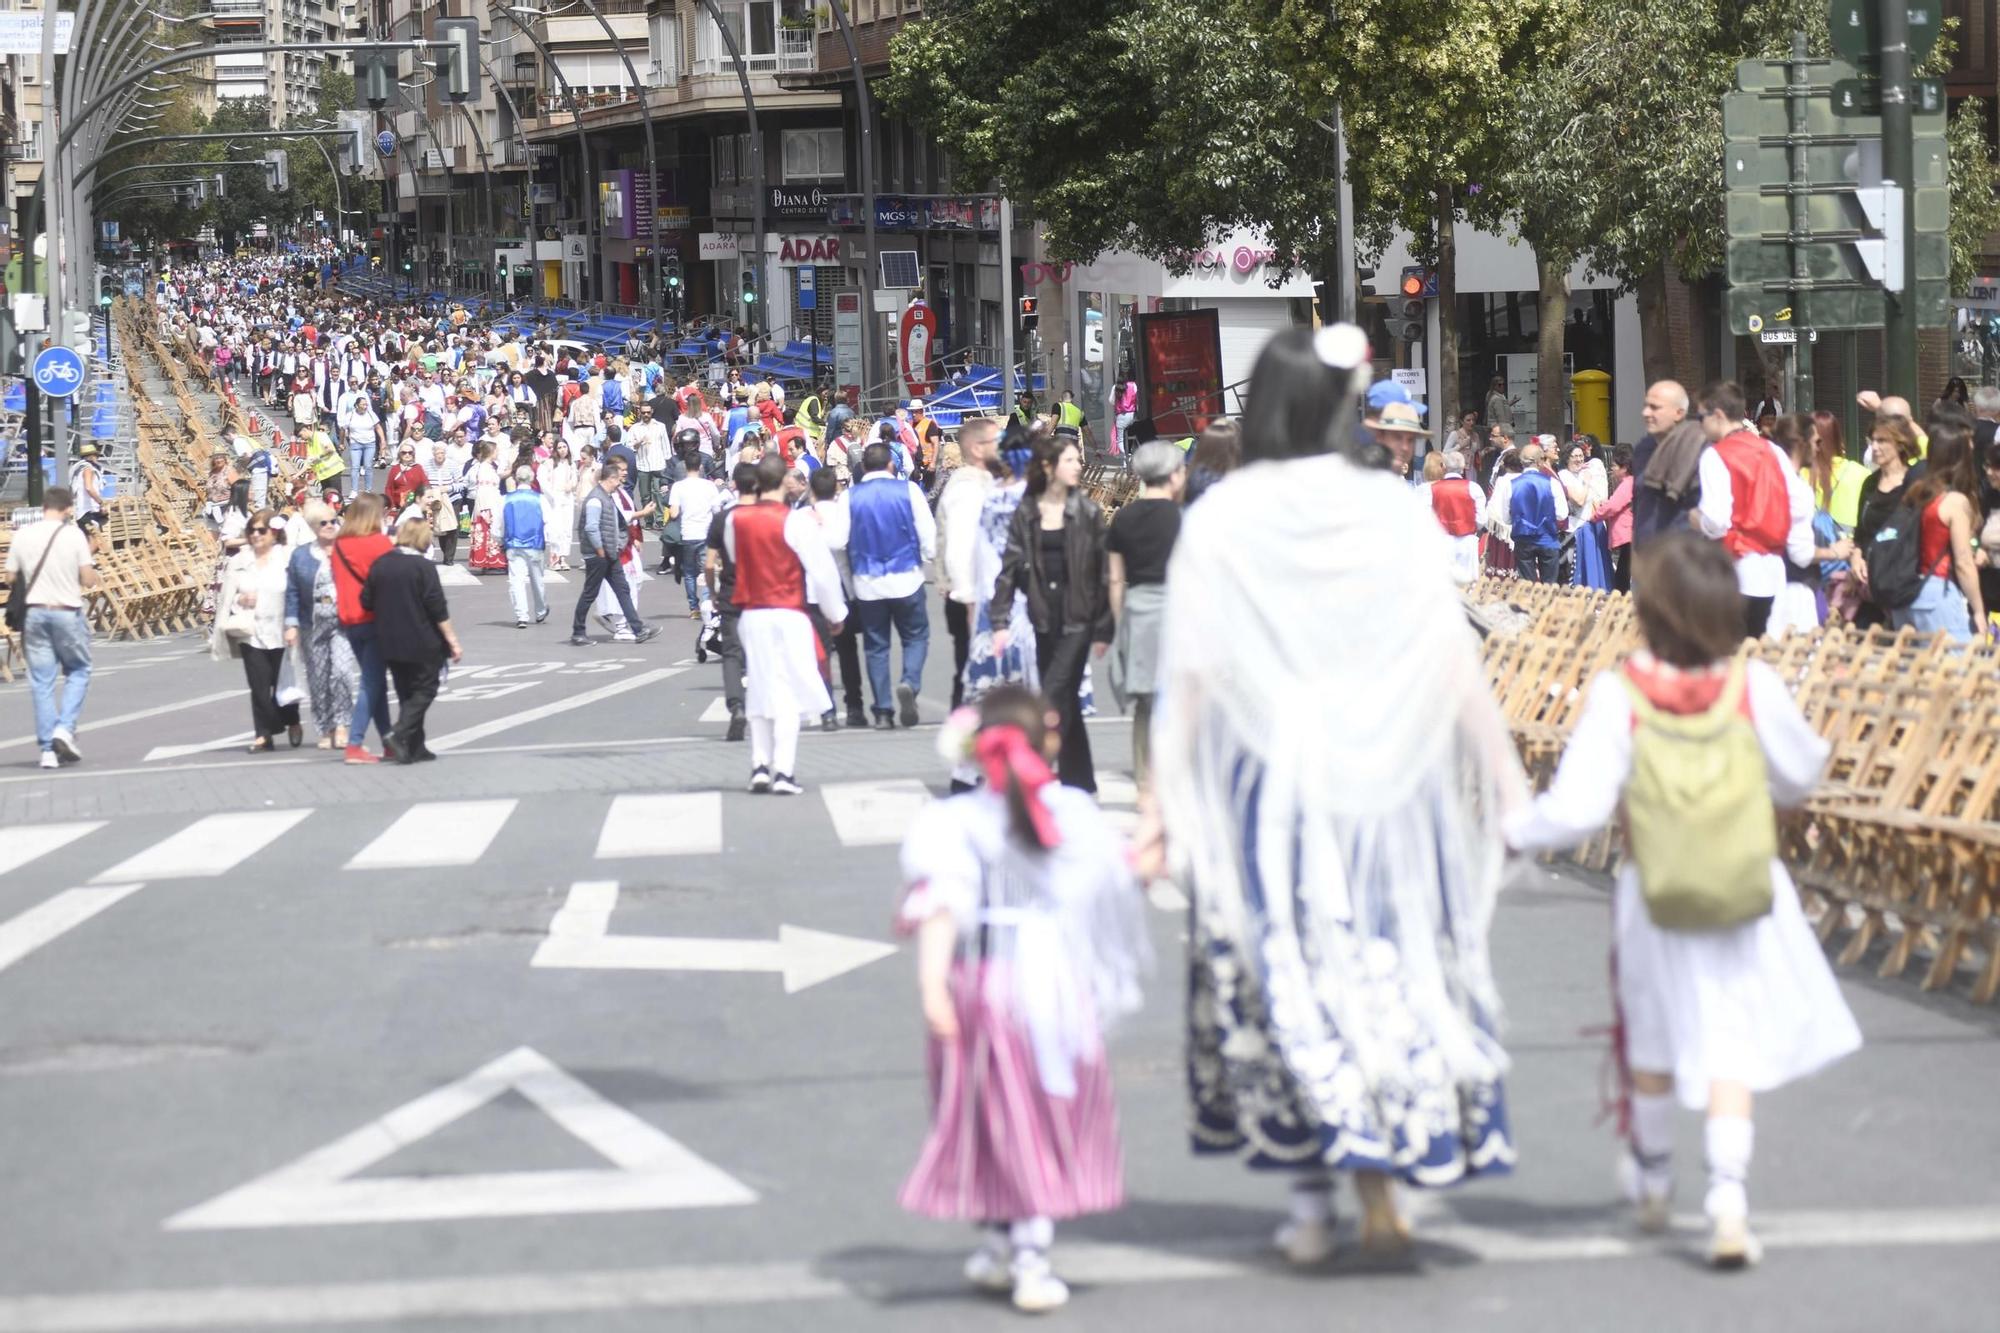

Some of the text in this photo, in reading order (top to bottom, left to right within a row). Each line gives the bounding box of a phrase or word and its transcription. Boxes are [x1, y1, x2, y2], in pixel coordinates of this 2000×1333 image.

[773, 189, 808, 207] DIANA
[880, 211, 905, 220] MGS
[702, 242, 736, 251] ADARA
[780, 238, 840, 261] ADAR
[1762, 332, 1779, 341] BUS
